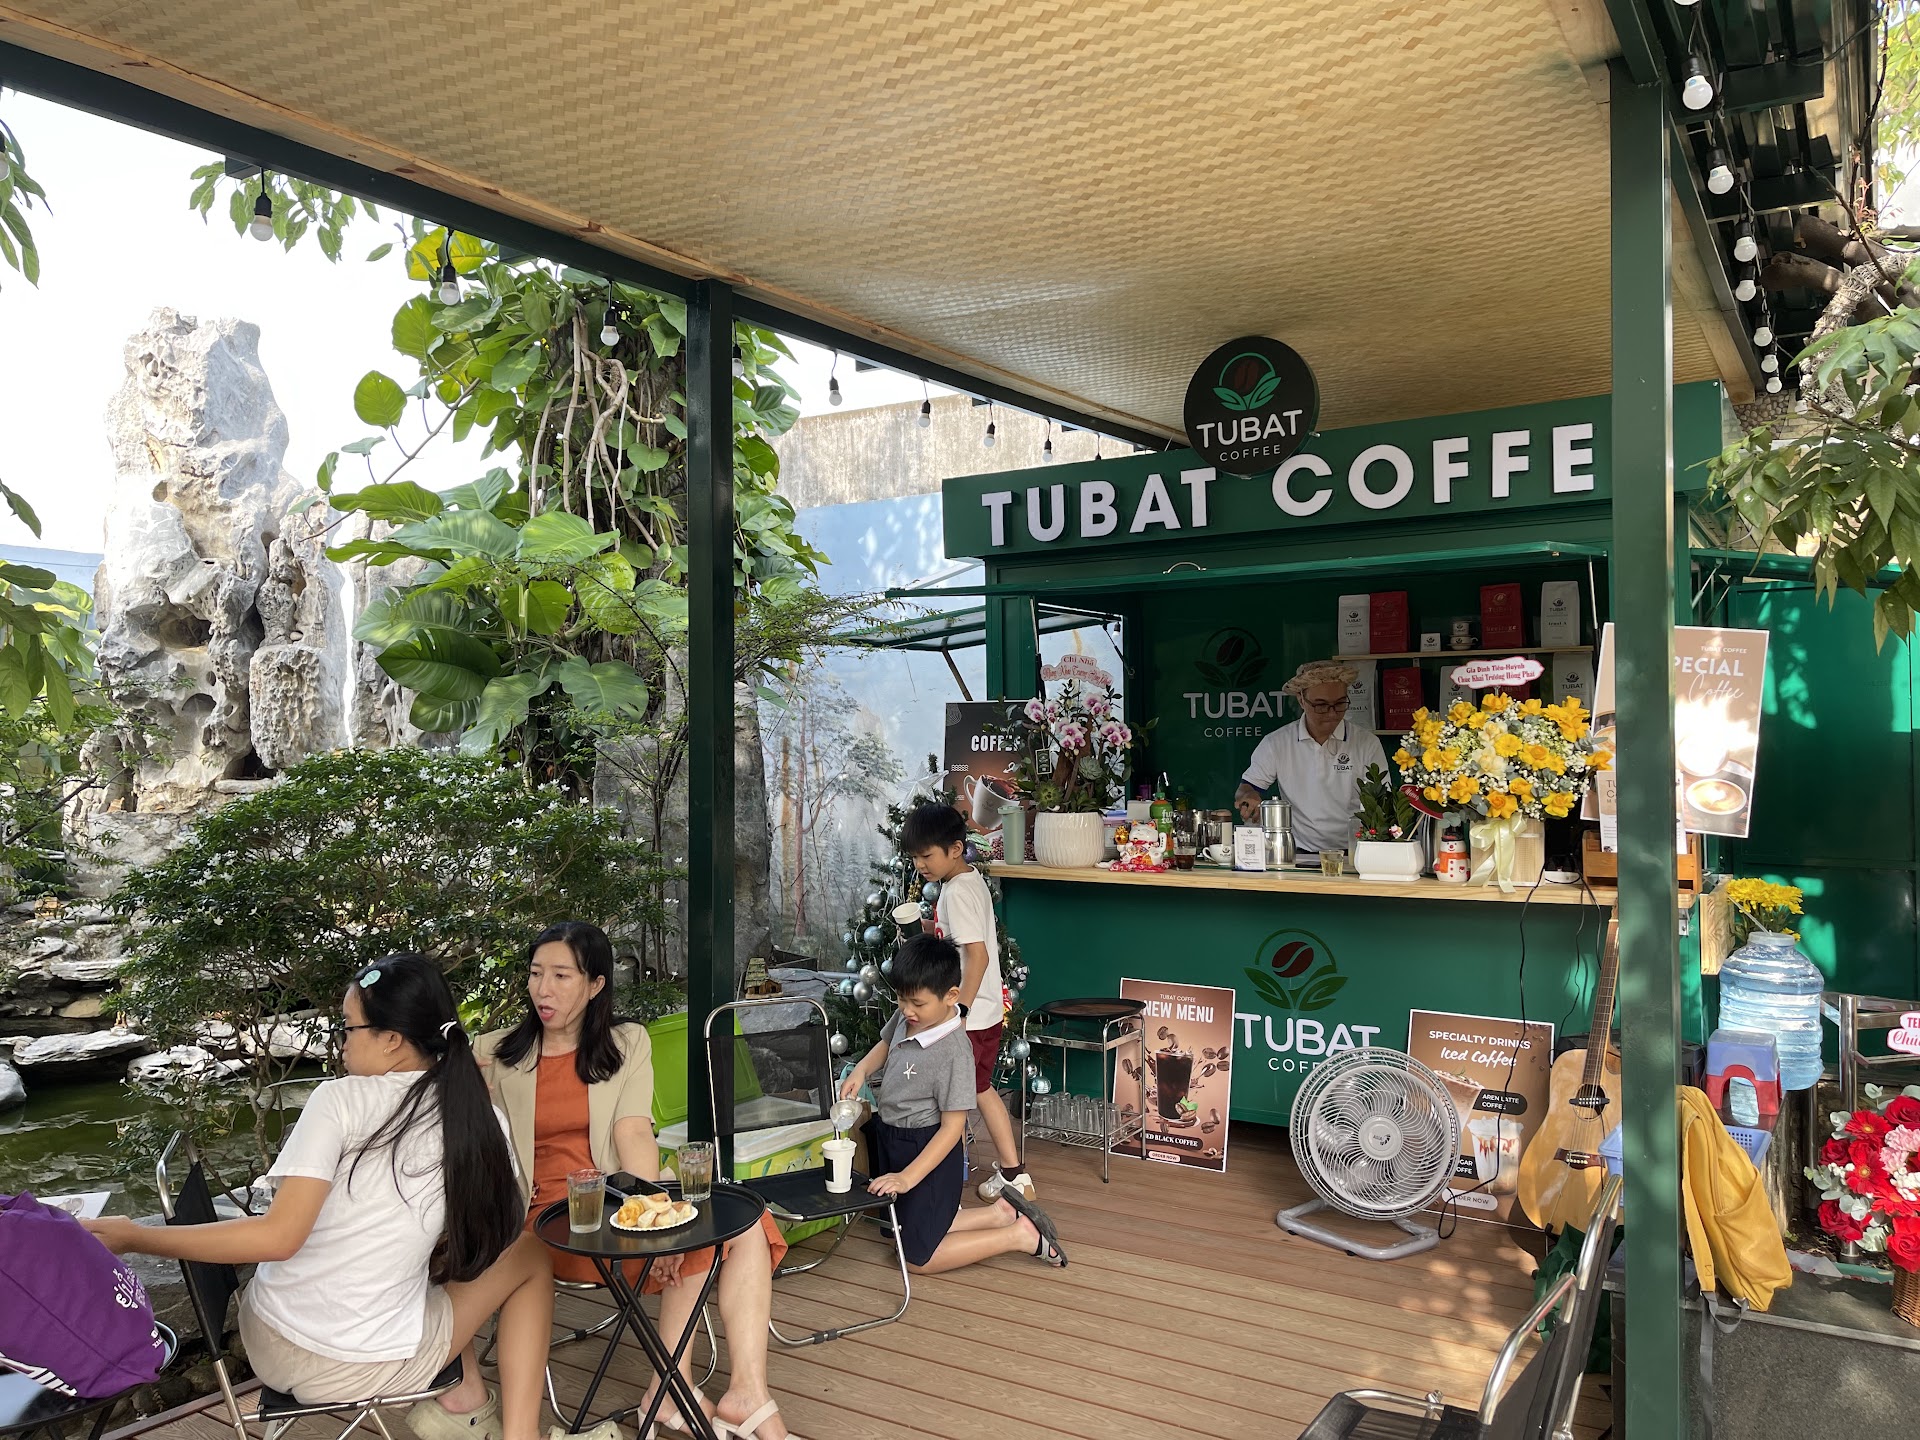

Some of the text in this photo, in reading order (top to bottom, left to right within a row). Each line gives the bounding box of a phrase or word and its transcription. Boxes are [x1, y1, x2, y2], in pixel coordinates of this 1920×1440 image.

[1196, 409, 1303, 448] TUBAT
[1220, 444, 1281, 462] COFFEE
[981, 422, 1595, 547] TUBAT COFFE
[1466, 666, 1476, 674] Gia
[1674, 656, 1744, 677] PECIAL
[1471, 674, 1484, 683] Khai
[1183, 690, 1289, 719] TUBAT
[1203, 727, 1262, 738] COFFEE
[1177, 995, 1196, 1003] COFFEE
[1143, 1000, 1214, 1023] NEW MENU
[1234, 1012, 1380, 1057] TUBAT
[1429, 1030, 1532, 1050] SPECIALTY DRINKS
[1440, 1046, 1517, 1068] Iced Coffee
[1482, 1093, 1500, 1102] AREN
[1154, 1133, 1175, 1145] BLACK
[1174, 1137, 1199, 1148] COFFEE
[1151, 1152, 1167, 1160] ORDER
[1459, 1159, 1473, 1167] GAR
[1456, 1167, 1473, 1175] OFFE
